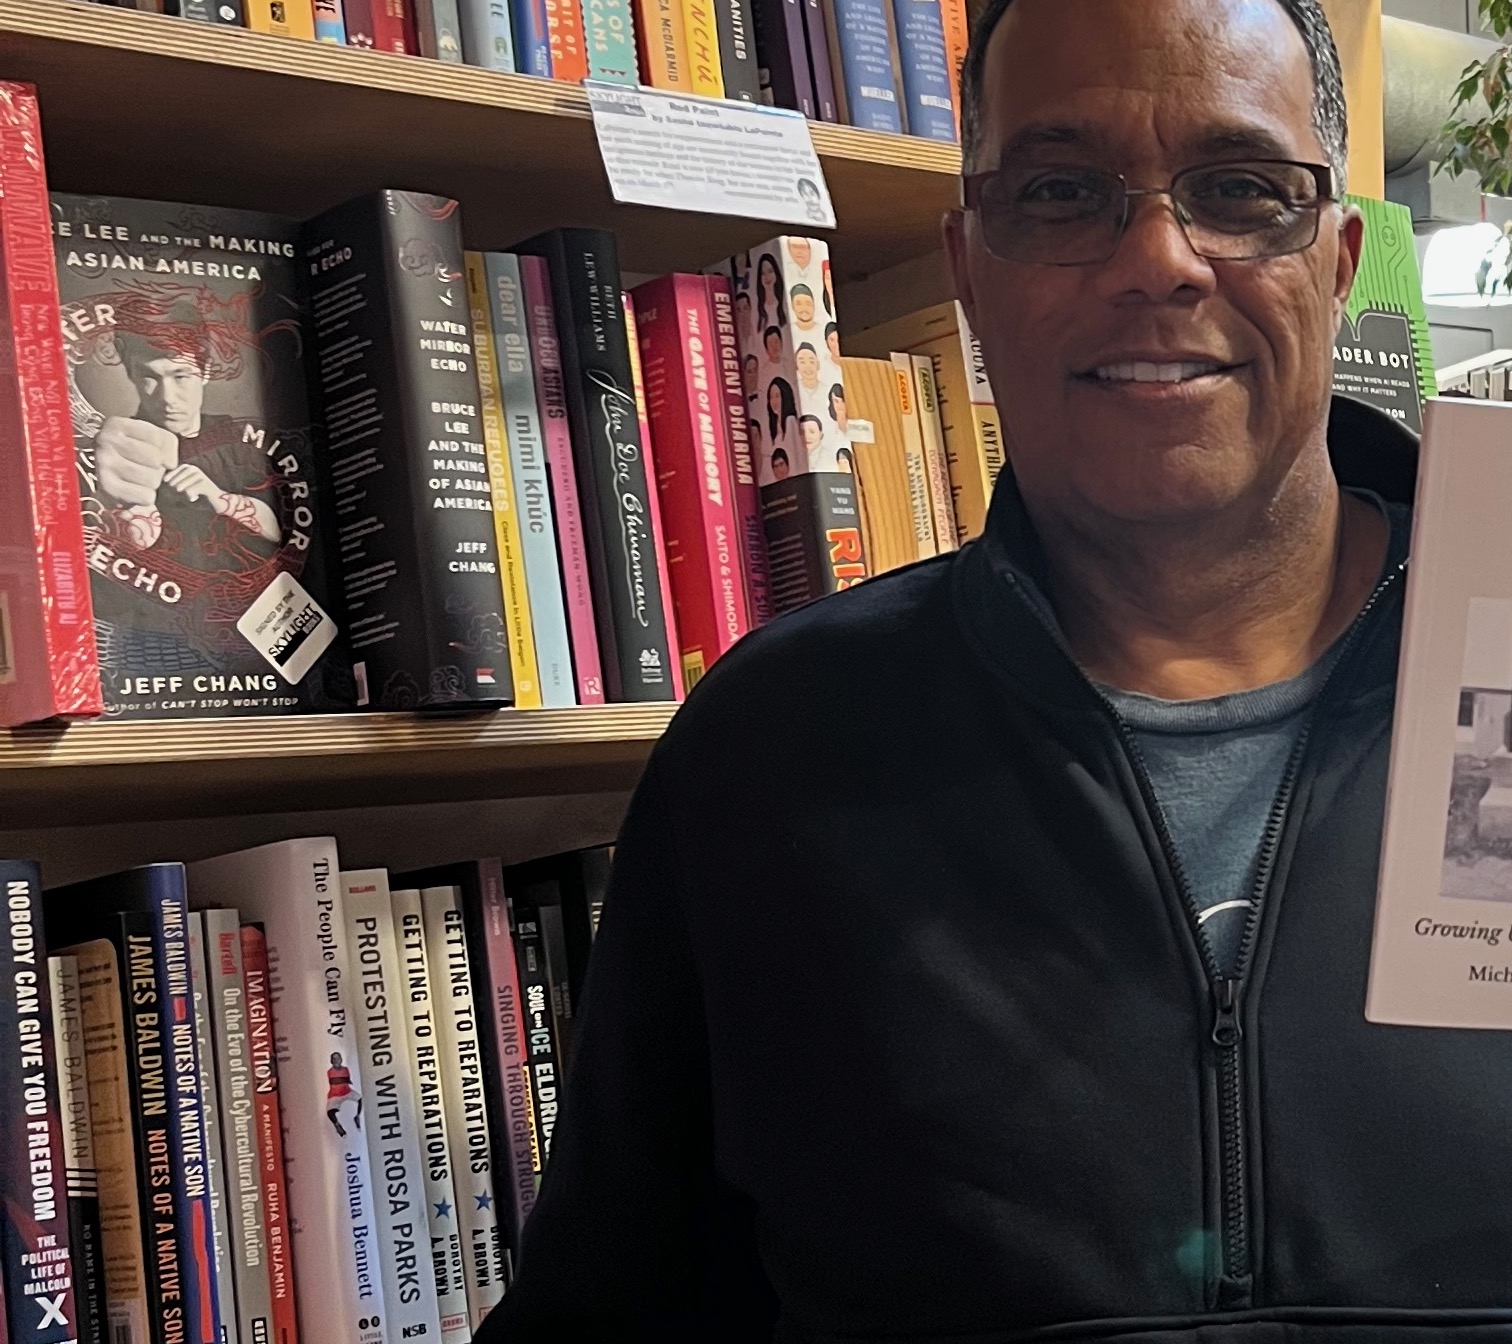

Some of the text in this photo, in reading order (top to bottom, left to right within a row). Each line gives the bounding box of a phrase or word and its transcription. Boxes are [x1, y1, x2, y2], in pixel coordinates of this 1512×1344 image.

[84, 223, 295, 258] LEE AND THE MAKING
[66, 251, 262, 281] ASIAN AMERICA
[420, 320, 467, 336] WATER
[498, 275, 527, 374] dear ella
[420, 339, 471, 355] MIRROR
[1332, 345, 1409, 370] ADER BOT
[430, 358, 468, 373] ECHO
[714, 291, 754, 486] EMERGENT DHARMA
[431, 402, 476, 417] BRUCE
[444, 421, 470, 435] LEE
[242, 424, 314, 551] MIRROR
[515, 414, 545, 535] mimi khúc
[456, 542, 487, 554] JEFF
[90, 544, 182, 604] ECHO
[449, 561, 496, 574] CHANG
[120, 674, 278, 695] JEFF CHANG
[201, 698, 229, 708] STOP
[272, 696, 299, 706] STOP
[1414, 917, 1503, 946] Growing
[313, 858, 347, 1038] The People Can Fly
[128, 934, 157, 1005] JAMES
[7, 881, 56, 1221] NOBODY CAN GIVE YOU FREEDOM
[403, 914, 448, 1182] GETTING TO REPARATIONS
[135, 1012, 168, 1116] BALDWIN
[356, 916, 421, 1305] PROTESTING WITH ROSA PARKS
[147, 1129, 169, 1187] NOTES
[152, 1194, 174, 1216] OF
[155, 1223, 175, 1236] A
[345, 1152, 374, 1301] Joshua Bennett
[37, 1235, 57, 1248] THE
[21, 1247, 70, 1266] POLITICAL
[31, 1263, 67, 1280] LIFE OF
[157, 1240, 181, 1303] NATIVE
[34, 1292, 69, 1330] X
[402, 1323, 428, 1339] NSB
